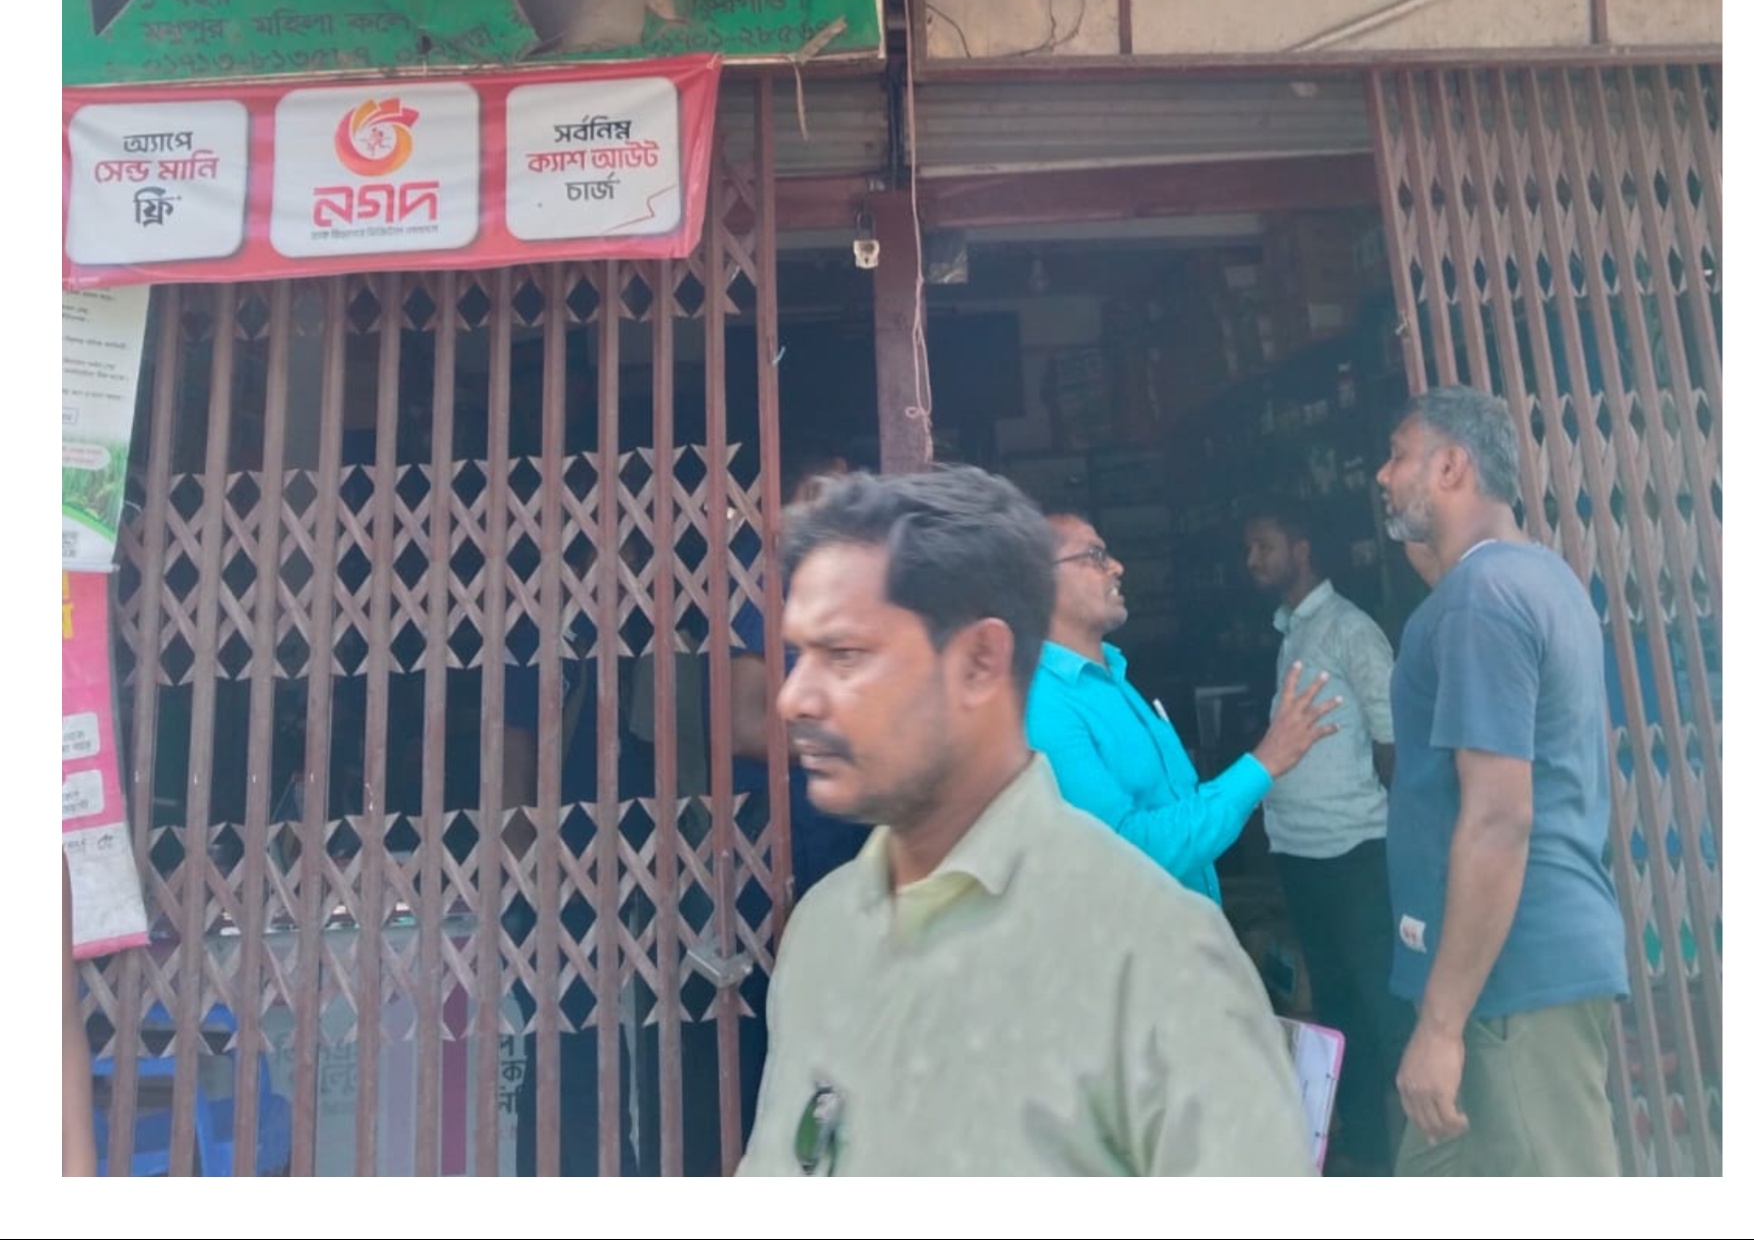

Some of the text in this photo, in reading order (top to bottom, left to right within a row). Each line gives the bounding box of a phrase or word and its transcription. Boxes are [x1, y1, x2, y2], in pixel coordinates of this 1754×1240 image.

[553, 115, 633, 144] সর্বনিম্ন
[94, 152, 220, 184] সেন্ড মানি
[527, 140, 660, 174] ক্যাশ আউট
[312, 180, 440, 227] নগদ
